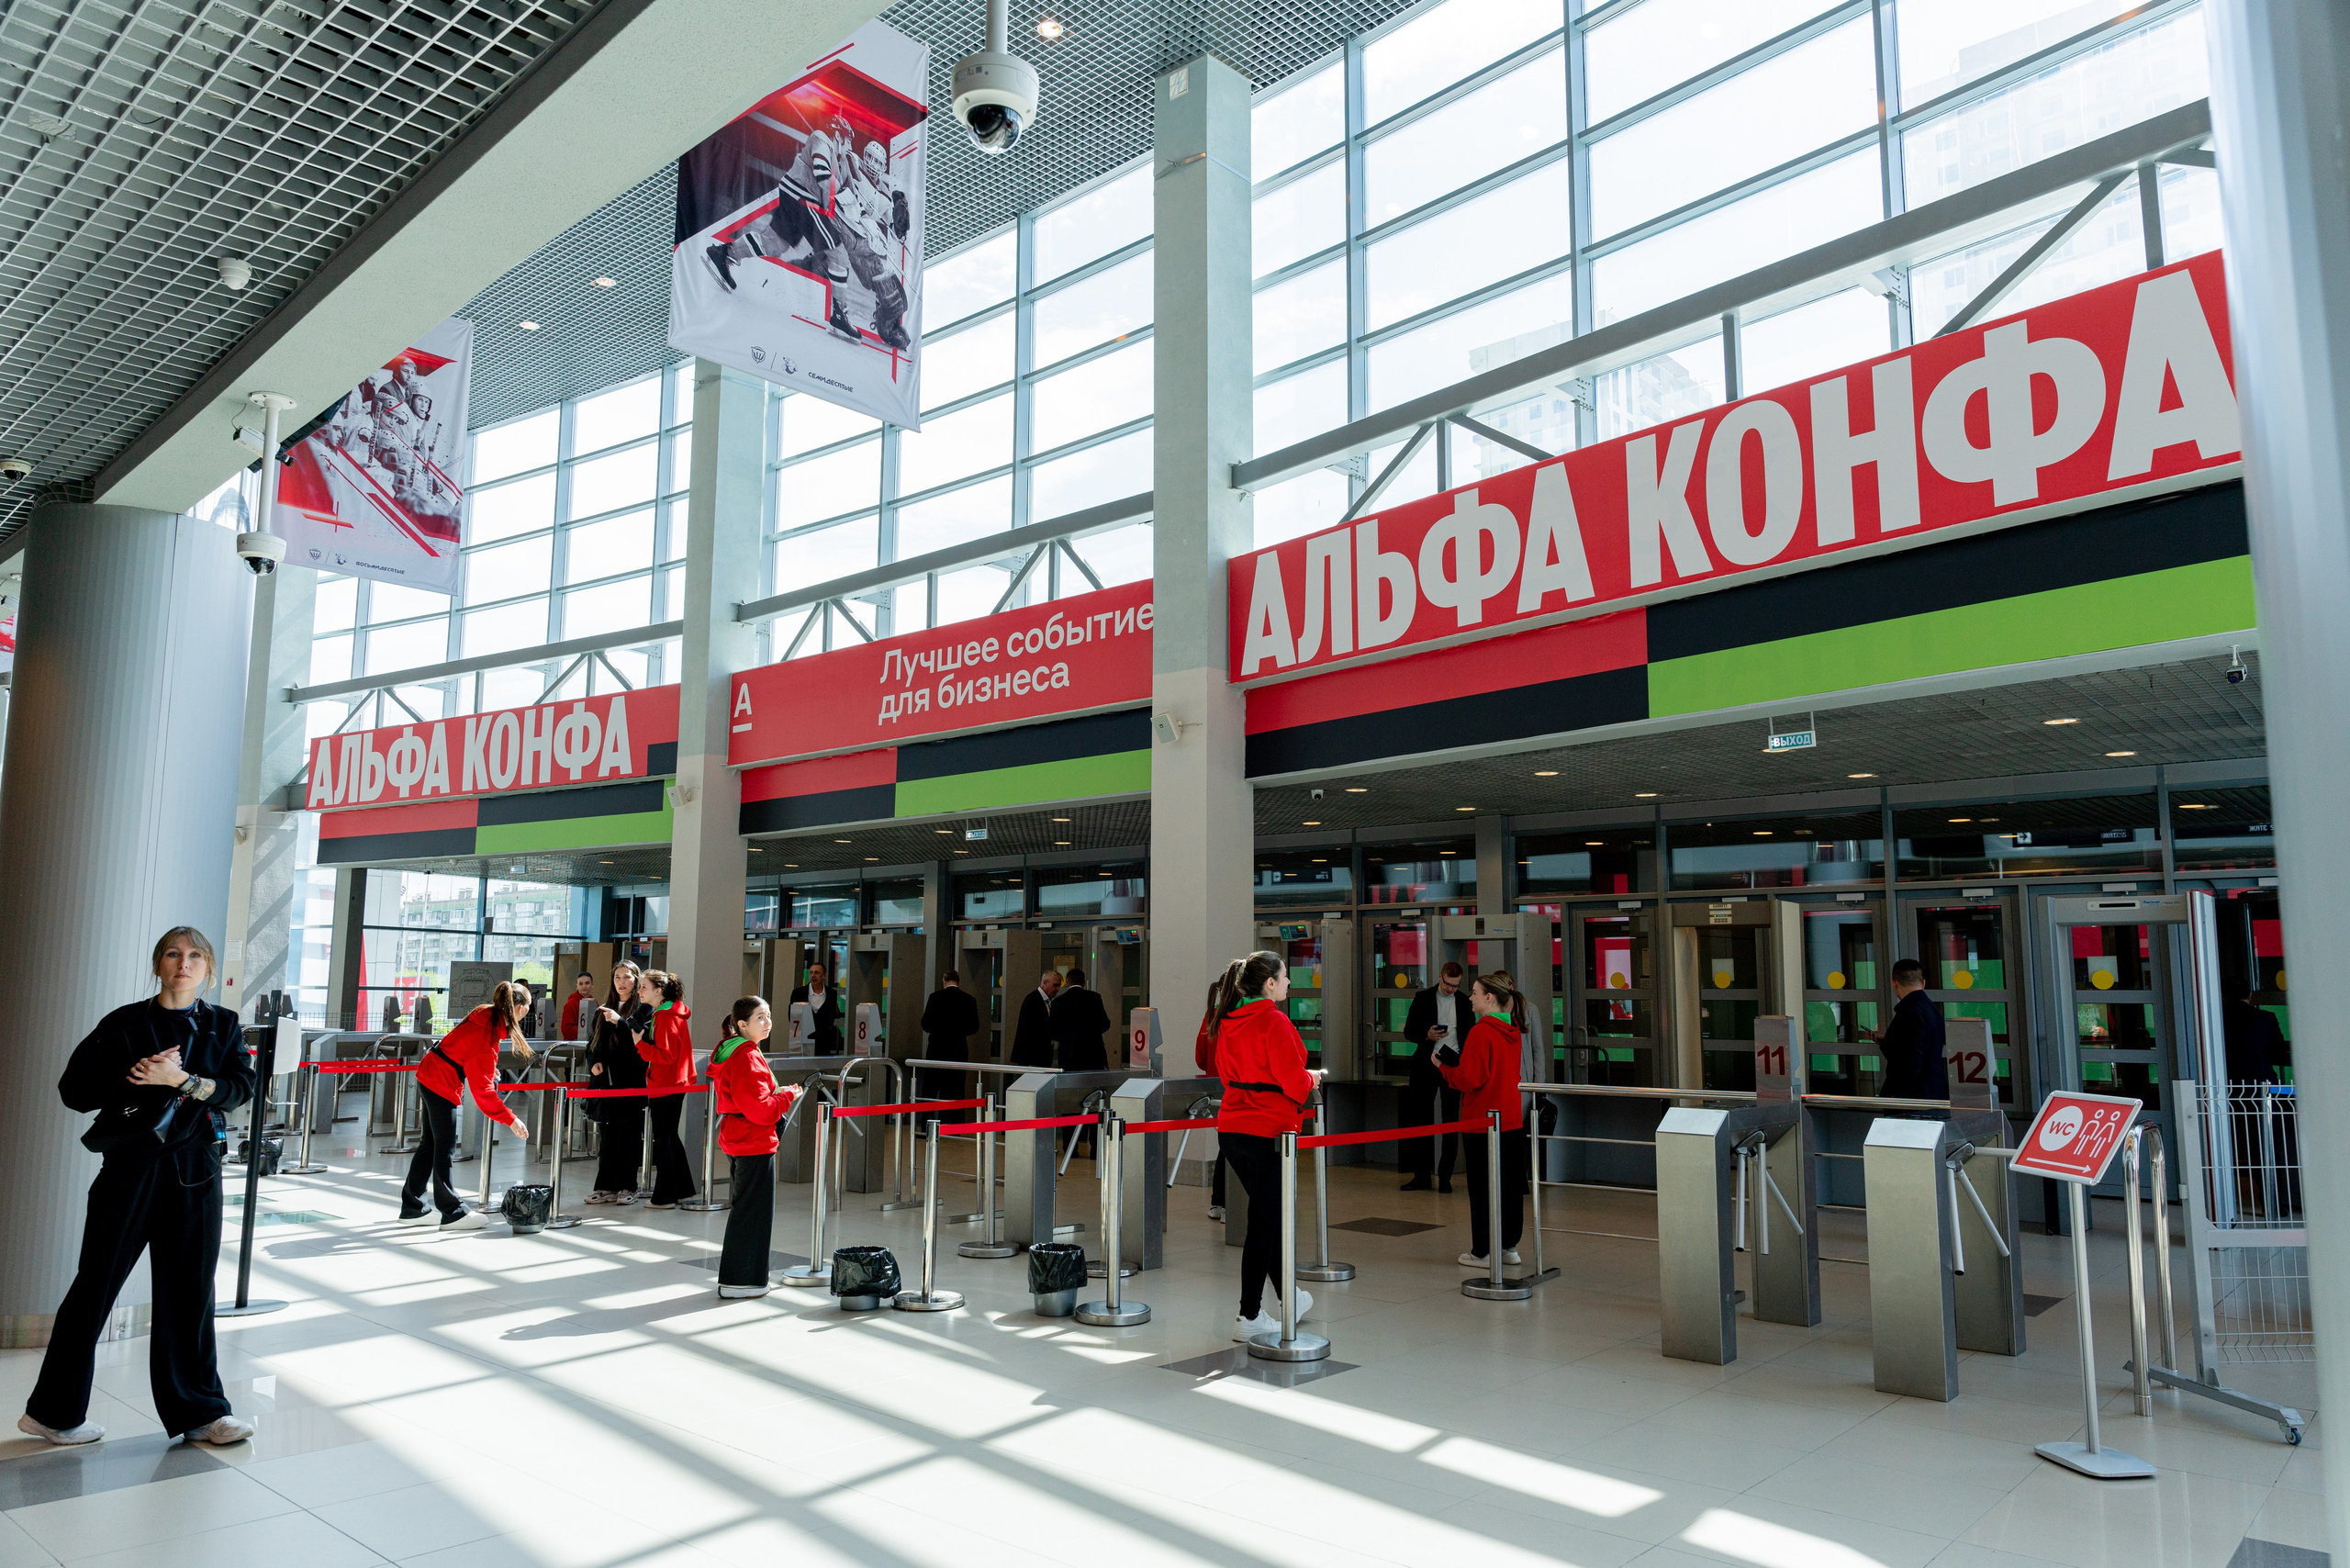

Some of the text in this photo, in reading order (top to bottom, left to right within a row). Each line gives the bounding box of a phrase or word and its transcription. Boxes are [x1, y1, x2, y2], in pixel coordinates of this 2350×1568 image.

[808, 372, 854, 392] СЕМИДЕСЯТЫЕ
[1240, 268, 2242, 677] АЛЬФА КОНФА
[879, 602, 1154, 688] Лучшее событие
[878, 662, 1070, 726] для бизнеса
[1774, 734, 1811, 747] ВЫХОД
[308, 695, 632, 808] АЛЬФА КОНФА
[414, 1010, 420, 1021] 4
[537, 1012, 543, 1027] 5
[580, 1013, 586, 1028] 6
[792, 1020, 800, 1038] 7
[858, 1021, 867, 1040] 8
[1134, 1029, 1146, 1052] 9
[1757, 1045, 1785, 1076] 11
[1948, 1051, 1988, 1084] 12
[2049, 1120, 2076, 1137] WC
